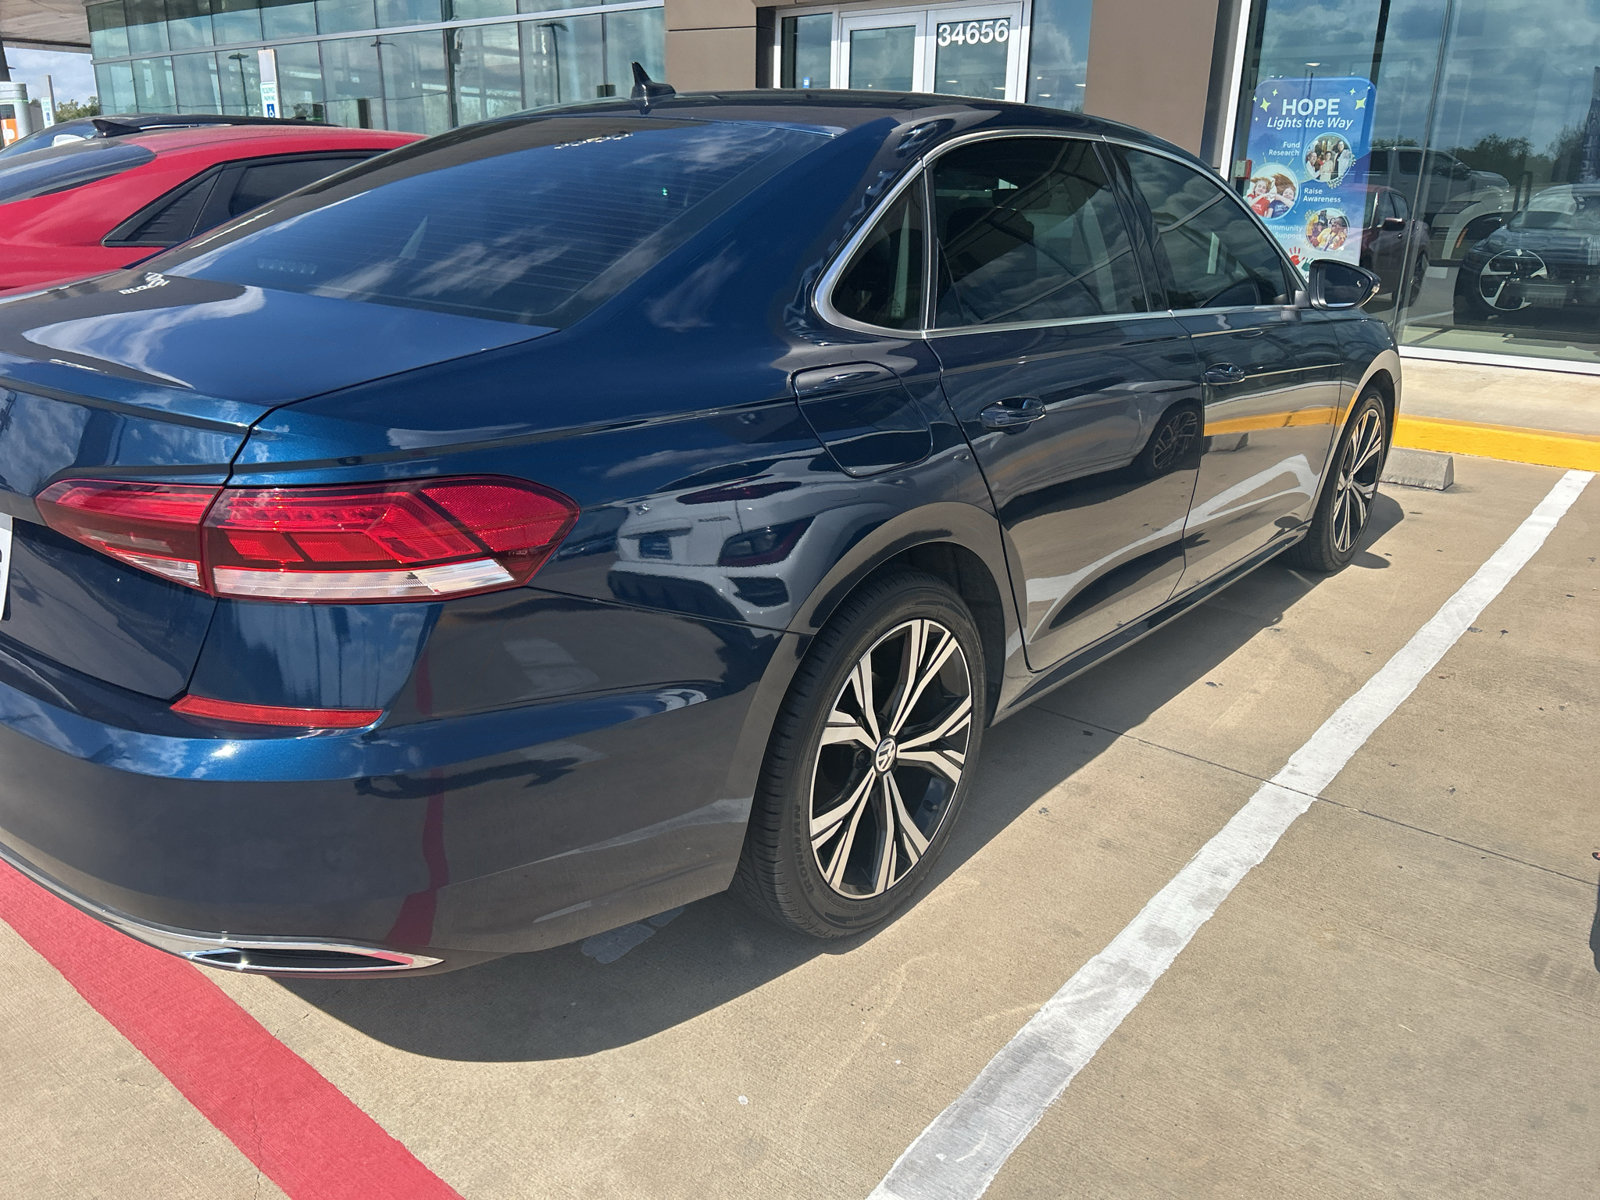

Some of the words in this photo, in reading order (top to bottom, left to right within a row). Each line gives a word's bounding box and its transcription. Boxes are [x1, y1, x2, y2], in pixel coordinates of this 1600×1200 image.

[937, 19, 1009, 47] 34656
[1281, 98, 1341, 116] HOPE
[1266, 116, 1302, 131] Lights
[1305, 116, 1325, 128] the
[1327, 117, 1354, 131] Way
[1282, 141, 1301, 149] Fund
[1268, 149, 1300, 157] Research
[1303, 187, 1323, 195] Raise
[1302, 195, 1342, 203] Awareness
